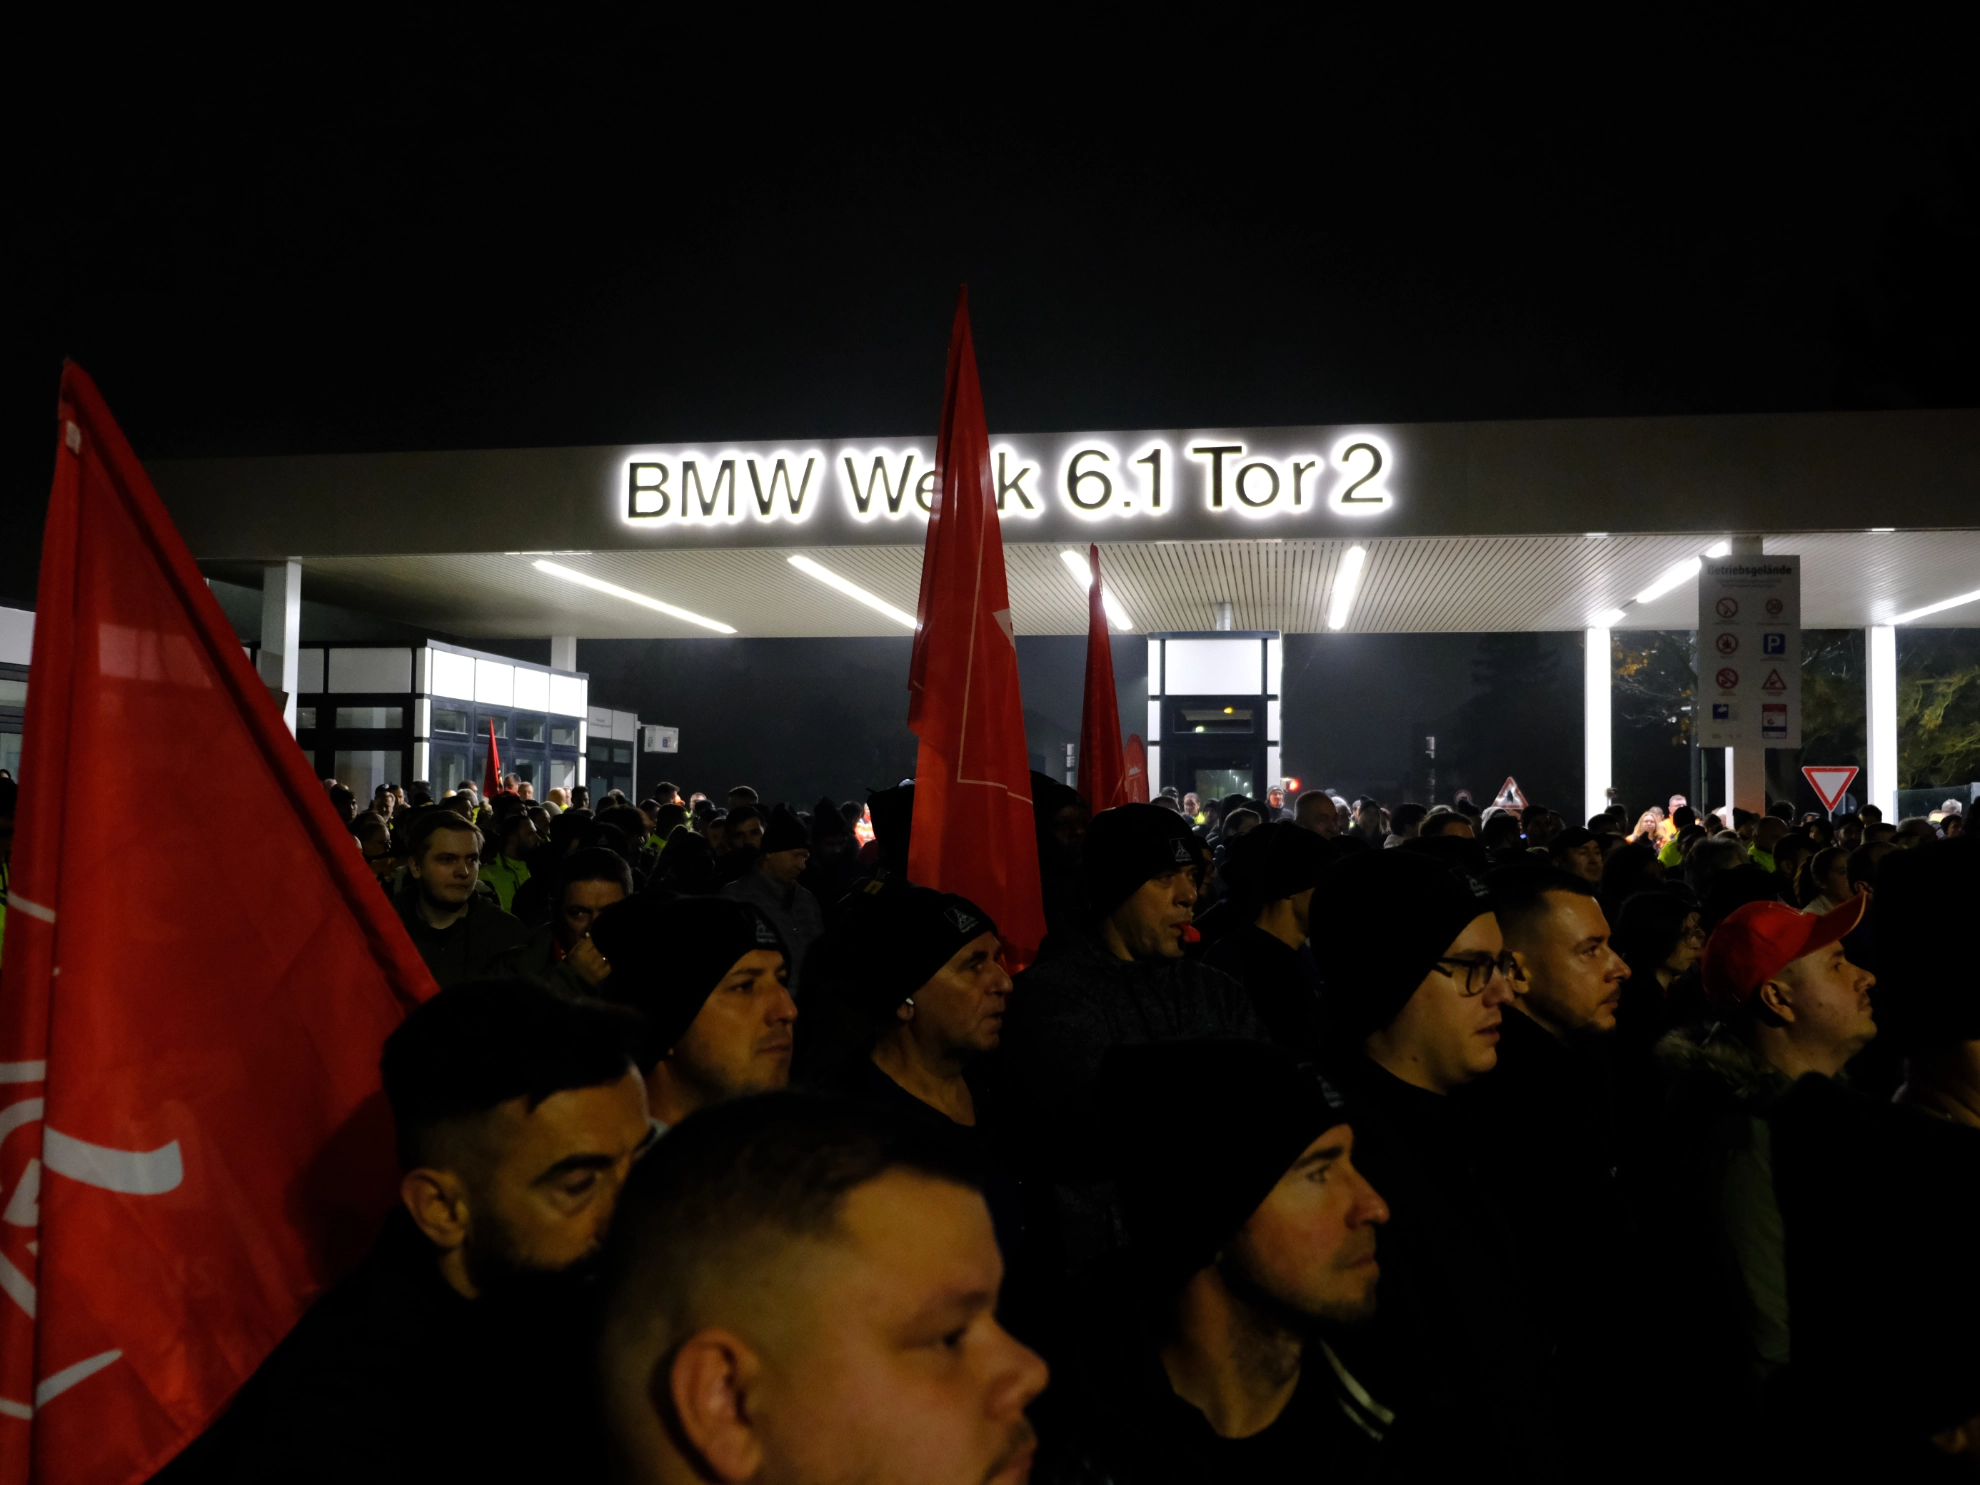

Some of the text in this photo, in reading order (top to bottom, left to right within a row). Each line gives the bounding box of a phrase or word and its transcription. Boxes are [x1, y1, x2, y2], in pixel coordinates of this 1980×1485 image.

[628, 442, 1384, 519] BMW Wek 6.1 Tor 2
[1707, 564, 1792, 577] Betriebsgelände
[1767, 635, 1781, 653] P
